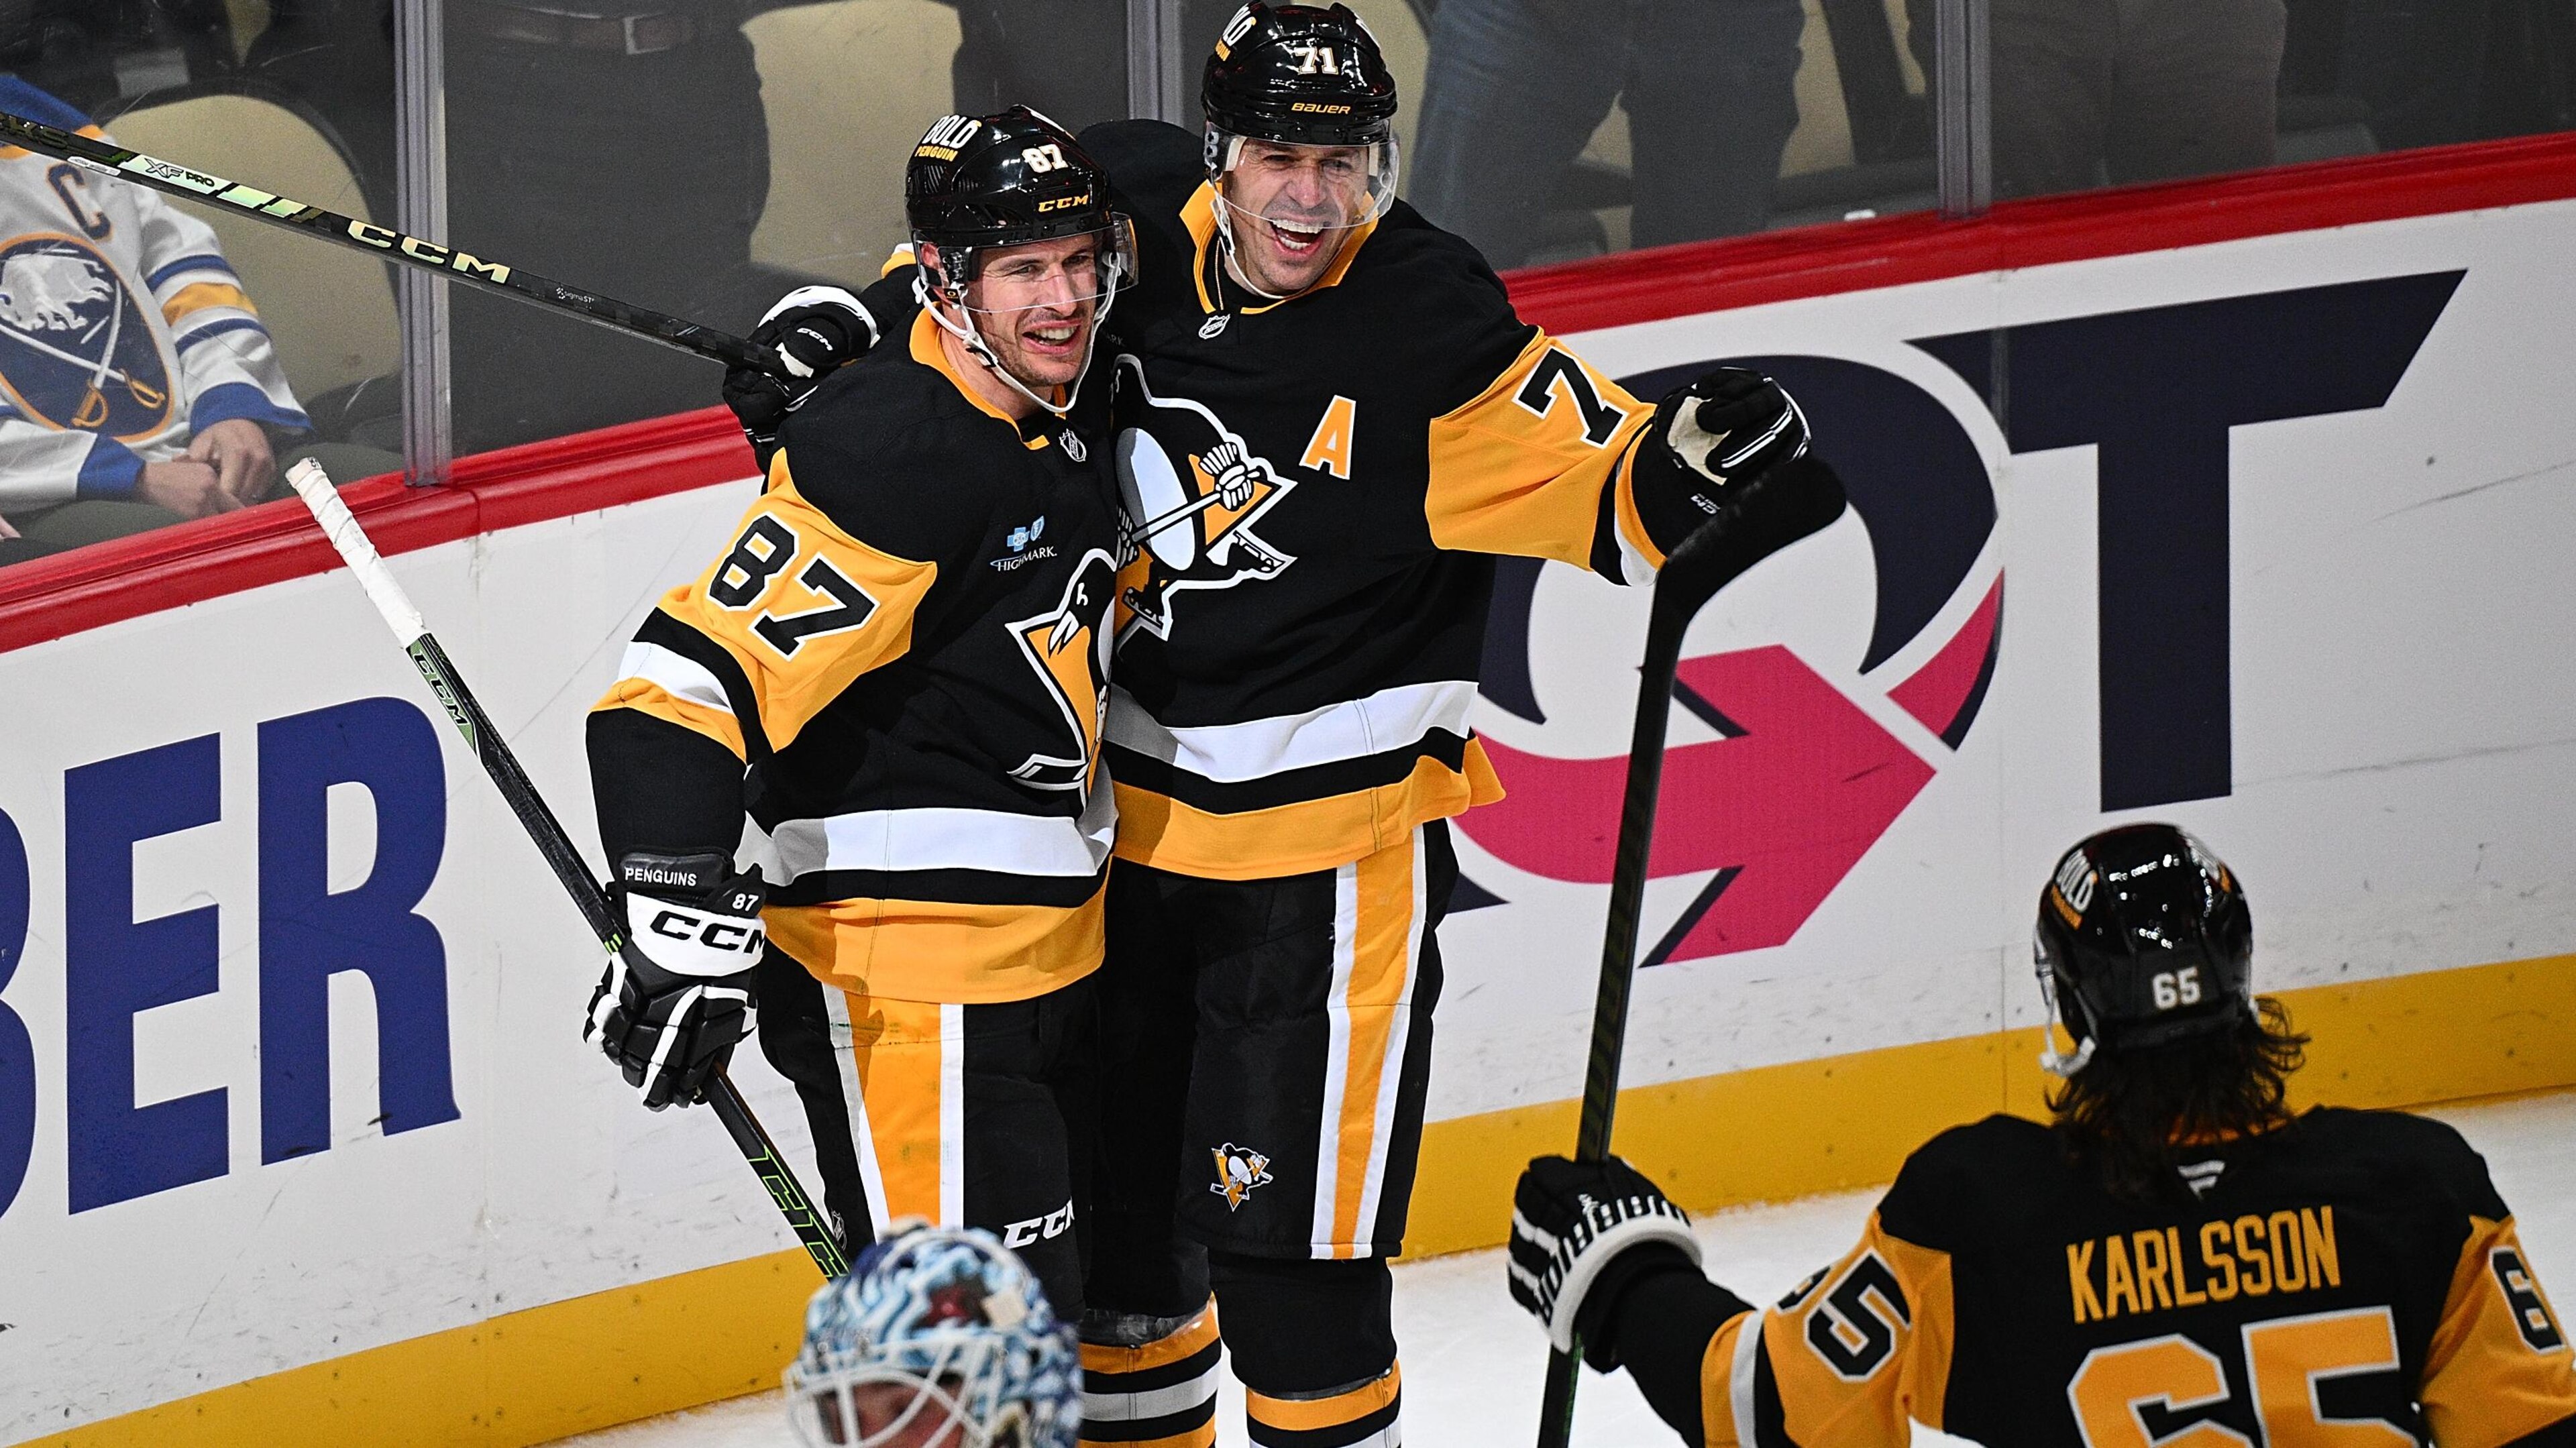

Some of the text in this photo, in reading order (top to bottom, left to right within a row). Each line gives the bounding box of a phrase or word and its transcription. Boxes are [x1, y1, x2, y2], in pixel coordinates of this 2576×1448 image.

[1294, 46, 1338, 74] 71
[914, 146, 958, 162] PENGUIN
[922, 115, 982, 149] BOLD
[144, 158, 215, 188] XF PRO
[1021, 144, 1069, 173] 87
[46, 162, 113, 243] C
[1038, 194, 1088, 213] CCM
[347, 219, 511, 284] CCM
[796, 327, 834, 351] CCM
[1511, 345, 1629, 450] 7
[1299, 394, 1356, 480] A
[706, 511, 881, 661] 87
[412, 651, 471, 727] CCM
[625, 867, 697, 886] PENGUINS
[732, 893, 759, 911] 87
[0, 696, 462, 1218] ER
[2151, 966, 2202, 1011] 65
[2065, 1205, 2342, 1325] KARLSSON
[2066, 1304, 2422, 1448] 65
